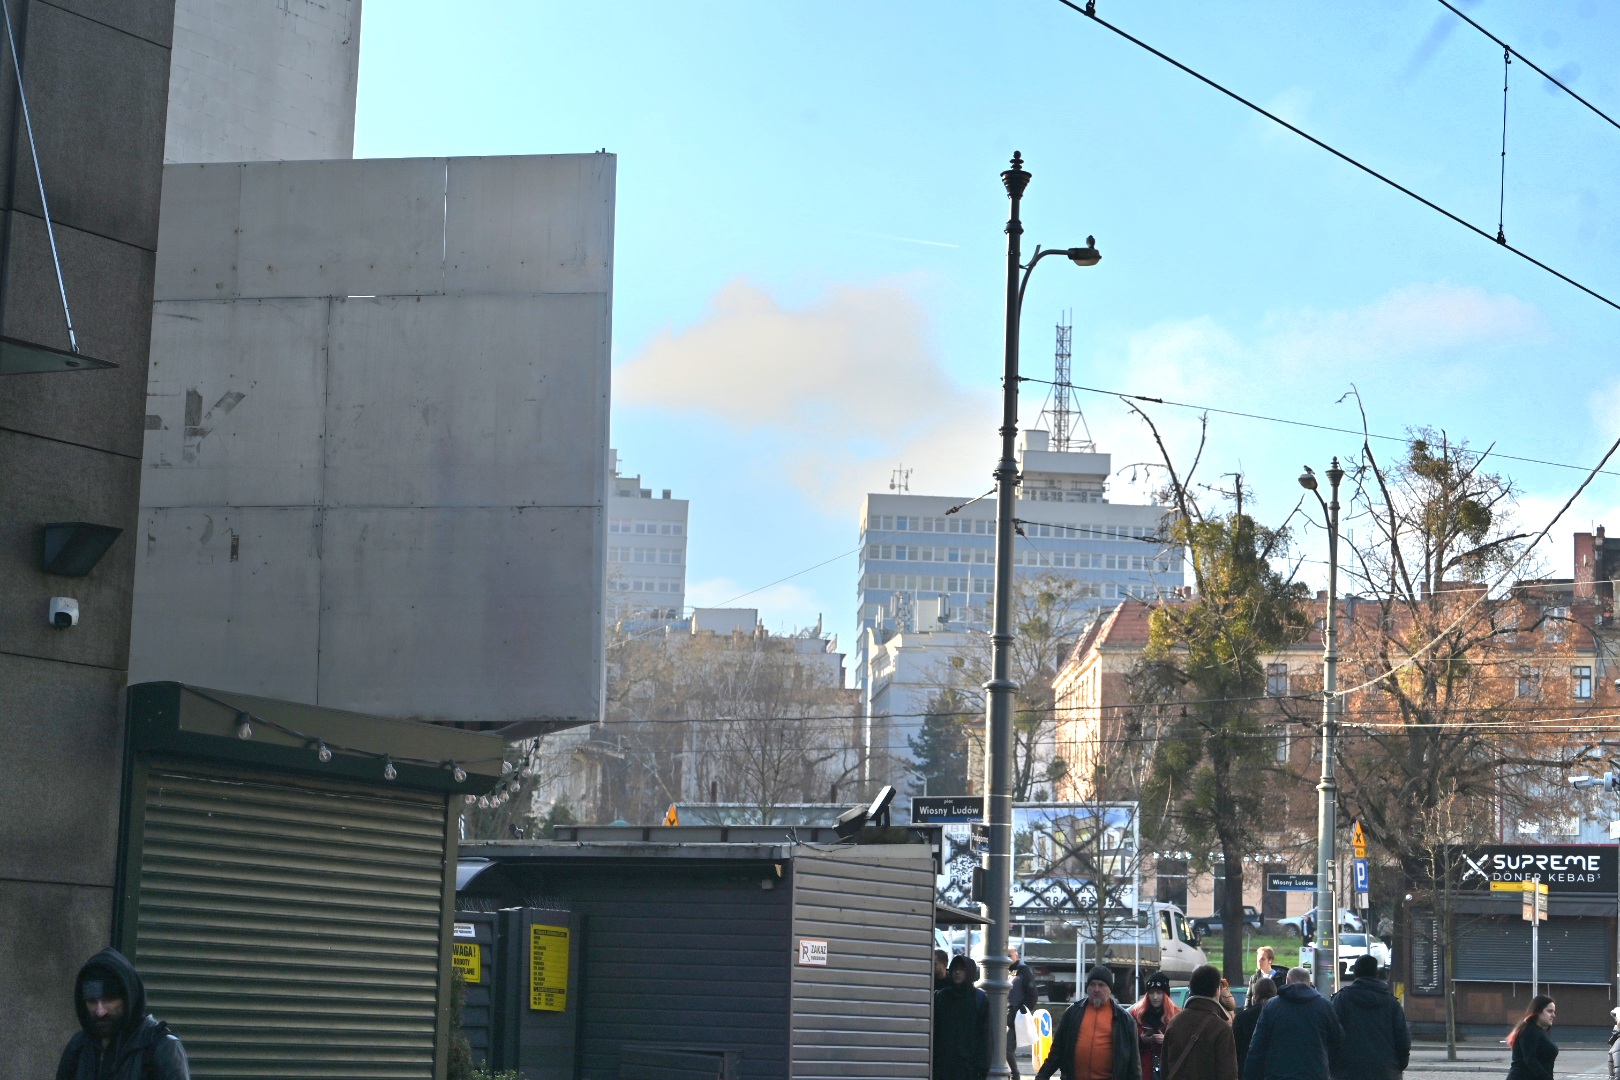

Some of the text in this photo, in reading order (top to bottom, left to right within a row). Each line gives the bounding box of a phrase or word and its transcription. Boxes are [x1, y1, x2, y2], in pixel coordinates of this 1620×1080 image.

[919, 805, 979, 816] Wiosny Ludów
[1493, 854, 1601, 871] SUPREME
[1493, 870, 1542, 882] DÖNER
[1272, 879, 1293, 887] Wiosny
[453, 944, 476, 957] WAGA!
[811, 945, 827, 954] ZAKAZ
